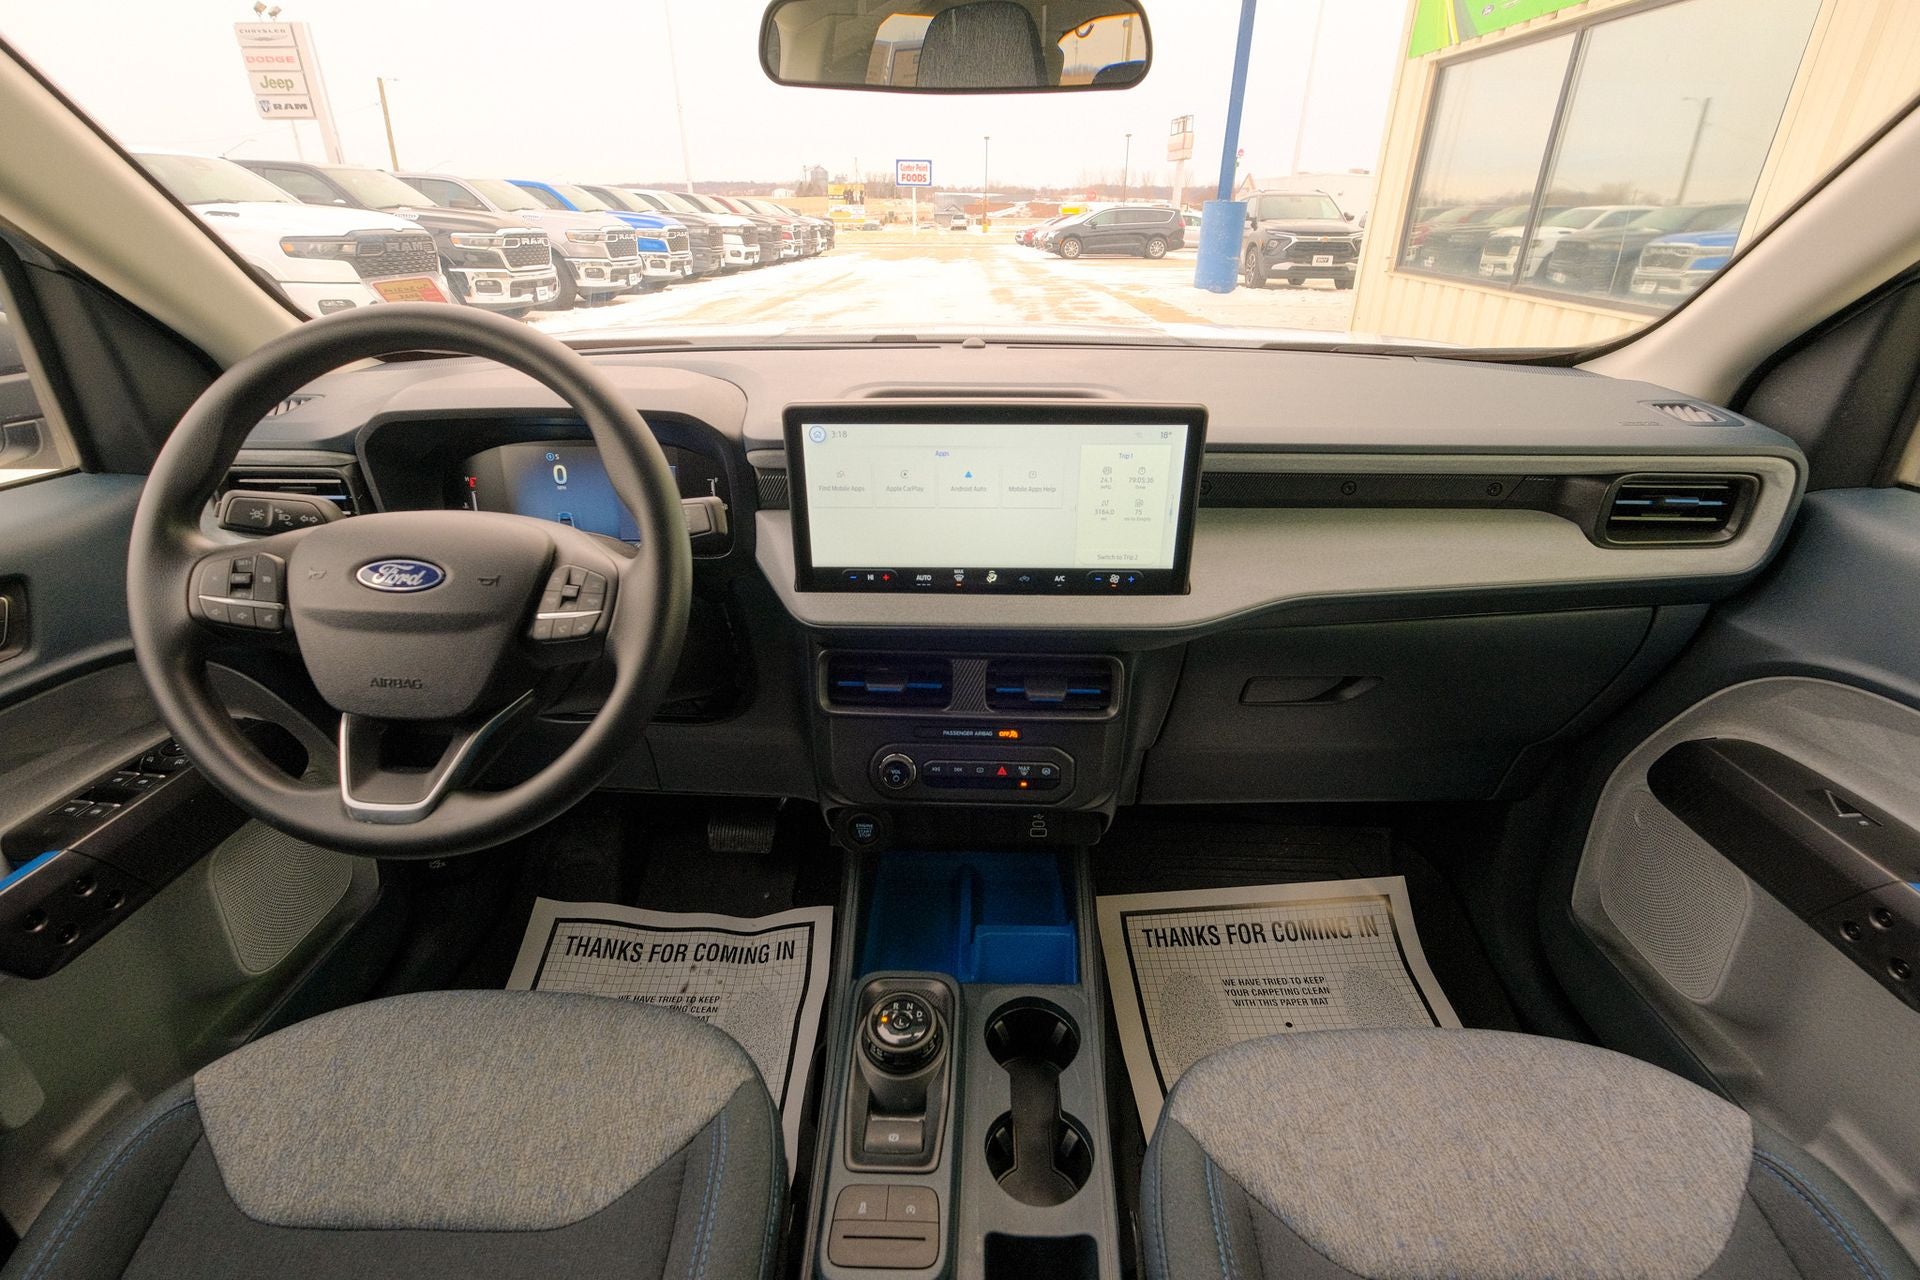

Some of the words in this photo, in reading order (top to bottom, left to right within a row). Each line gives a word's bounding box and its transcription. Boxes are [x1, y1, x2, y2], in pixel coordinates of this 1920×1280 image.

[245, 55, 296, 63] DODGE
[260, 75, 294, 91] Jeep
[901, 173, 927, 182] FOODS
[521, 237, 545, 245] RAM
[618, 233, 637, 241] RAM
[385, 242, 423, 252] RAM
[831, 430, 848, 439] 3:18
[553, 464, 568, 485] 0
[851, 485, 865, 493] Apps
[903, 485, 924, 493] CarPlay
[371, 563, 427, 586] Ford
[370, 677, 423, 690] AIRBAG
[1142, 924, 1221, 949] THANKS
[1225, 922, 1267, 945] FOR
[1270, 915, 1354, 944] COMING
[1356, 914, 1380, 938] IN
[565, 935, 643, 963] THANKS
[647, 943, 689, 963] FOR
[693, 942, 770, 965] COMING
[775, 940, 795, 960] IN
[1222, 978, 1236, 986] WE
[1238, 978, 1261, 986] HAVE
[1262, 977, 1288, 986] TRIED
[1290, 977, 1302, 985] TO
[1303, 976, 1325, 985] KEEP
[1224, 989, 1250, 997] YOUR
[1251, 987, 1300, 997] CARPETING
[1301, 986, 1330, 995] CLEAN
[633, 995, 656, 1003] HAVE
[656, 995, 682, 1003] TRIED
[686, 995, 697, 1003] TO
[699, 995, 720, 1004] KEEP
[1232, 999, 1257, 1007] WITH
[1258, 999, 1279, 1007] THIS
[1280, 998, 1309, 1006] PAPER
[1310, 997, 1329, 1006] MAT
[690, 1005, 719, 1013] CLEAN
[893, 1002, 899, 1010] R
[906, 1002, 914, 1010] N
[916, 1010, 923, 1018] D
[899, 1018, 904, 1026] L
